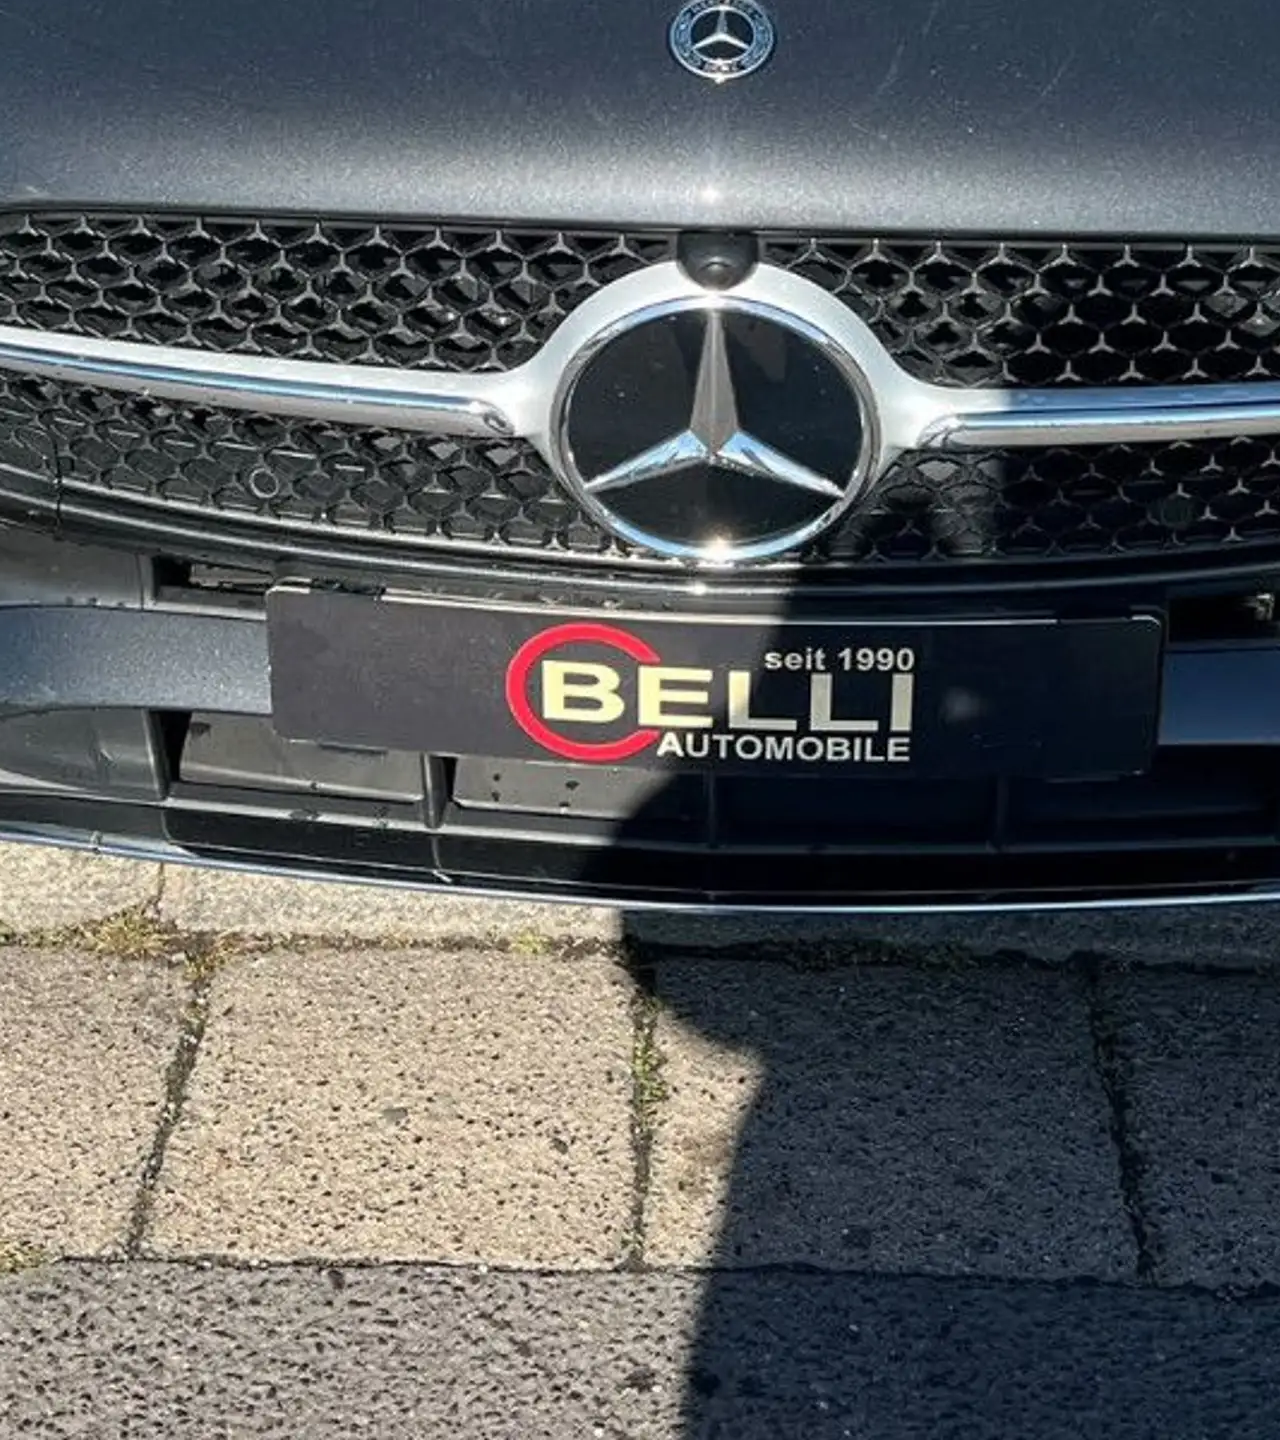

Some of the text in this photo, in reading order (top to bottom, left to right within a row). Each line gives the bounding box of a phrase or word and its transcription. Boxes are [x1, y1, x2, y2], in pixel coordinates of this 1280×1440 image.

[764, 646, 915, 672] seit 1990
[541, 659, 914, 732] BELLI
[655, 732, 911, 762] AUTOMOBILE
